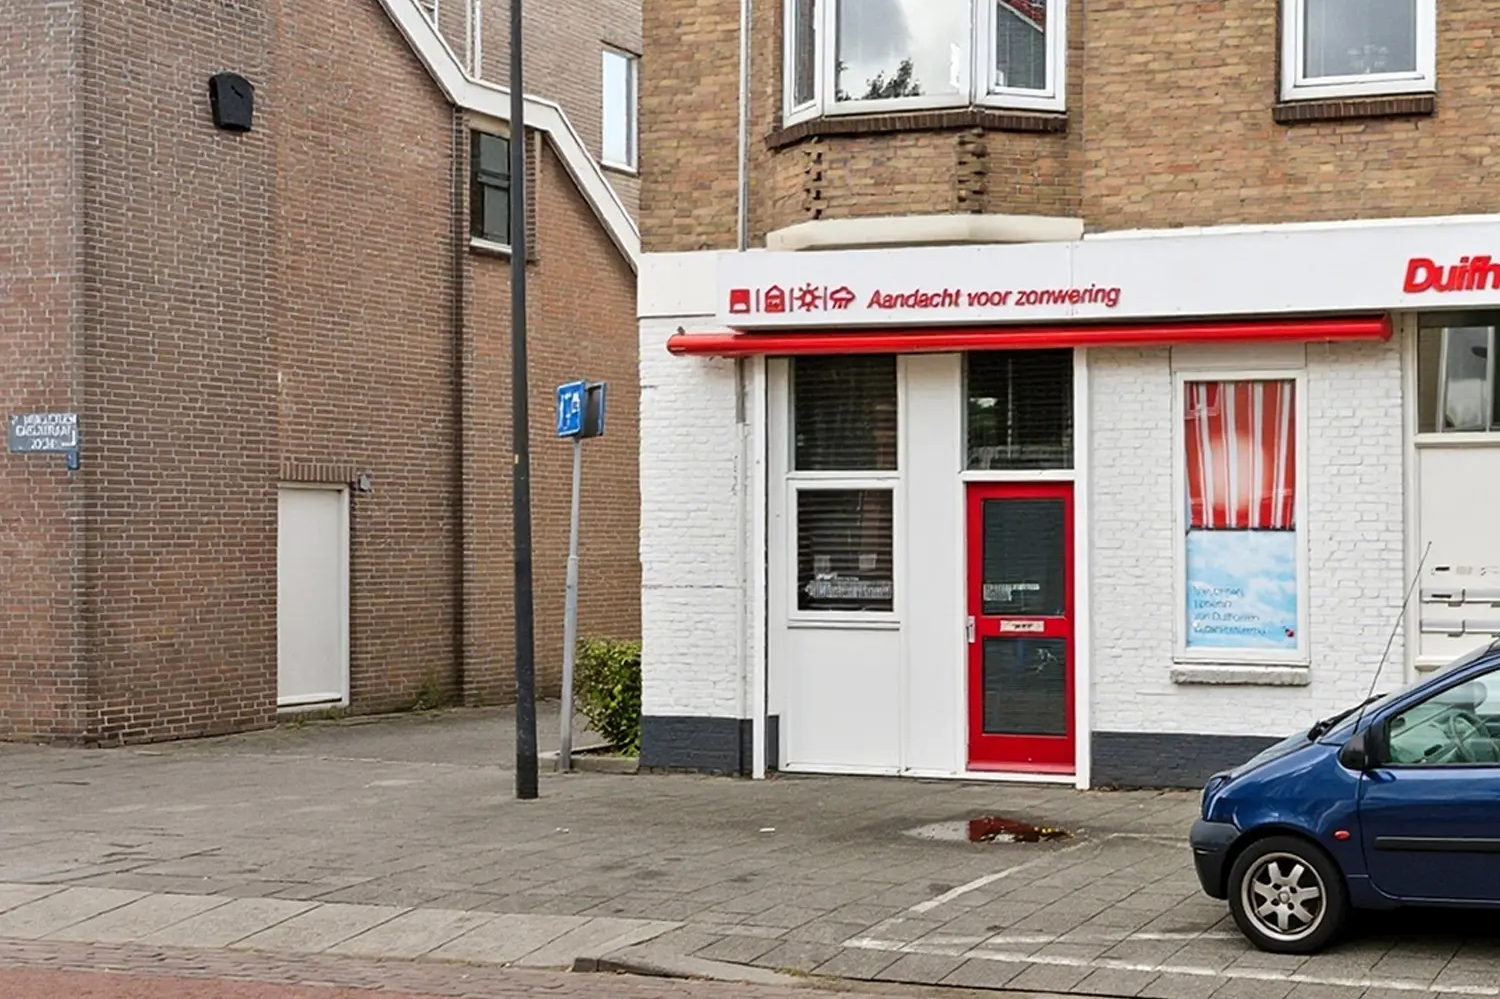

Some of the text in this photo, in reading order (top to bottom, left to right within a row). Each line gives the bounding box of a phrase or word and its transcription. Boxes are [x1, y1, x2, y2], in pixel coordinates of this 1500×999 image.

[867, 284, 1122, 310] Aandacht voor zonwering
